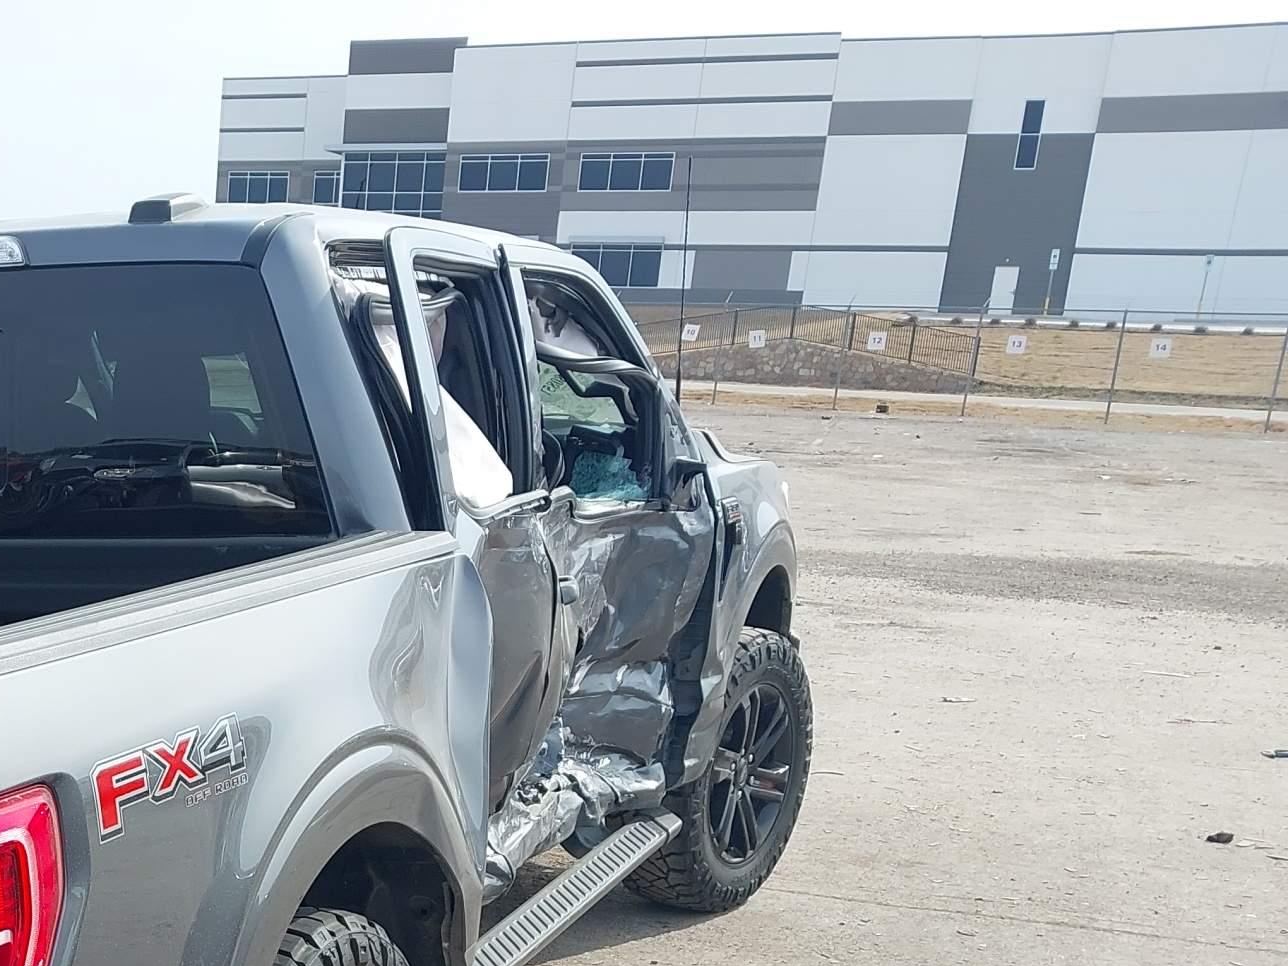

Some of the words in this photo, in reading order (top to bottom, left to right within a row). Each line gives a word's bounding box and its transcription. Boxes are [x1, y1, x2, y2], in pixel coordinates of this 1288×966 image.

[1012, 340, 1022, 348] 13
[1155, 343, 1167, 351] 14
[89, 711, 248, 845] FX4
[184, 787, 212, 808] OFF
[214, 772, 249, 797] ROAD
